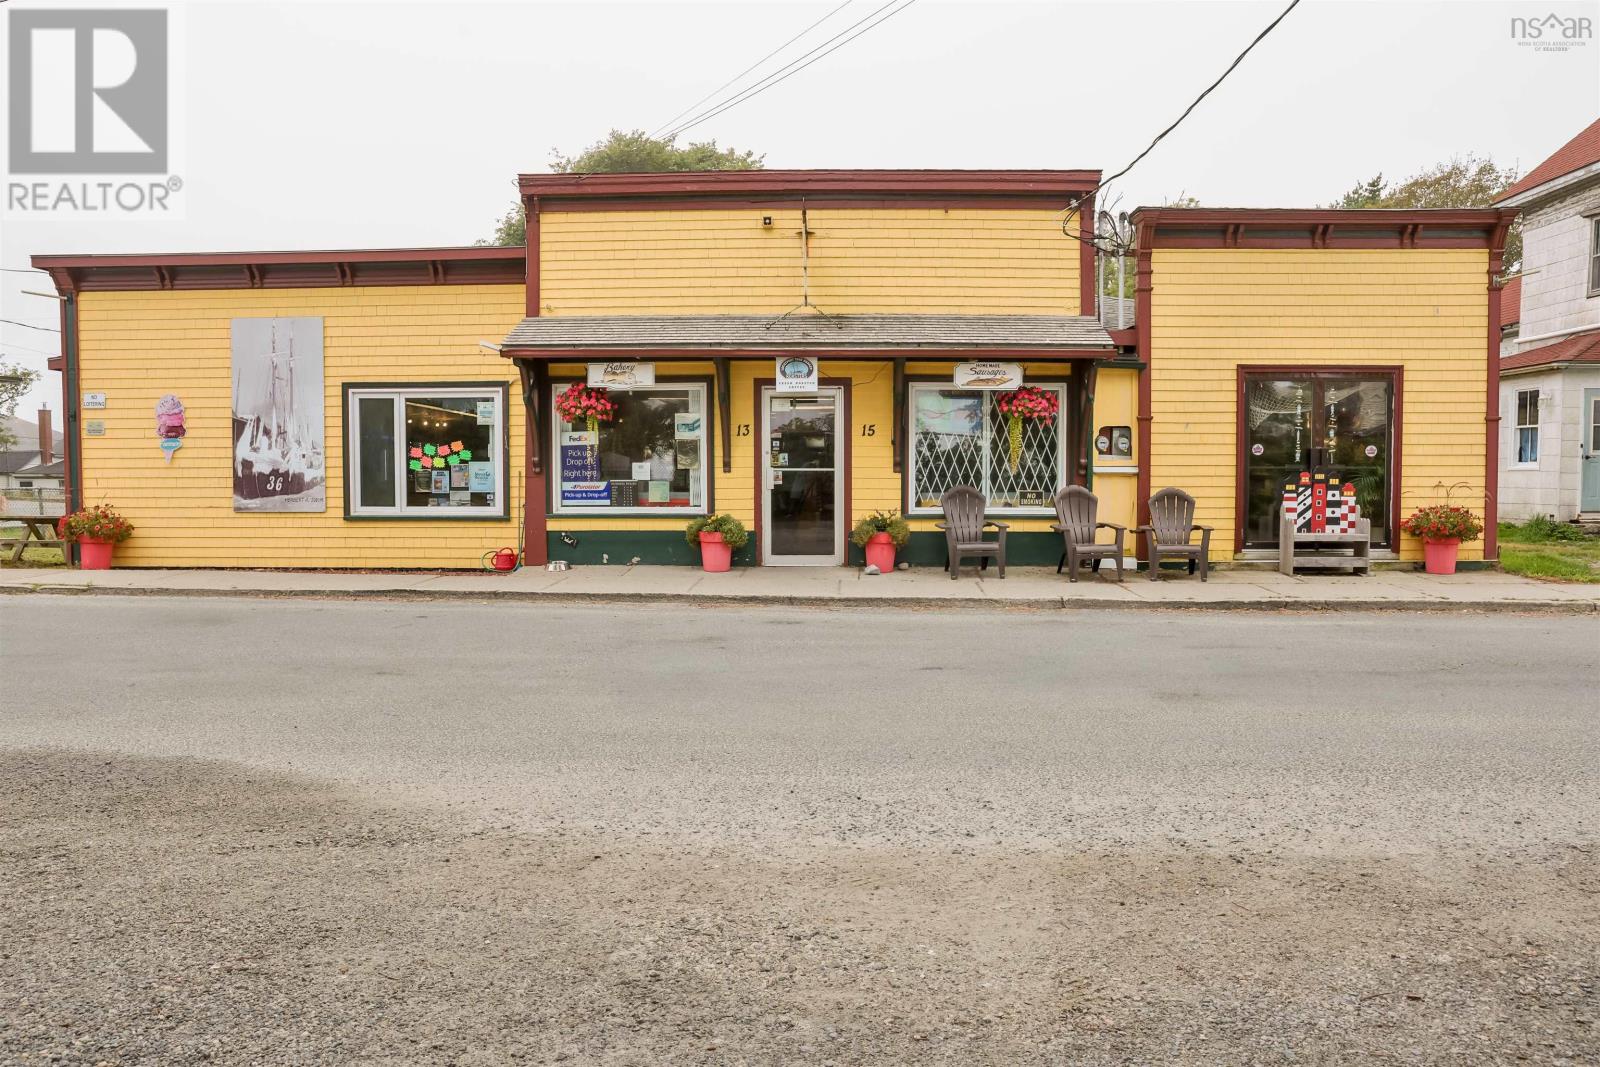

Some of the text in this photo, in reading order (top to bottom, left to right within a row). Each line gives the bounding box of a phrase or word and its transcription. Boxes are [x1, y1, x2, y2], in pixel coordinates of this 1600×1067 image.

[604, 362, 635, 373] Bakery
[969, 367, 1007, 377] Sausages
[737, 424, 750, 436] 13
[862, 424, 876, 436] 15
[568, 449, 582, 457] Pick
[567, 458, 583, 466] Drop
[564, 470, 581, 479] Right
[267, 476, 283, 490] 36
